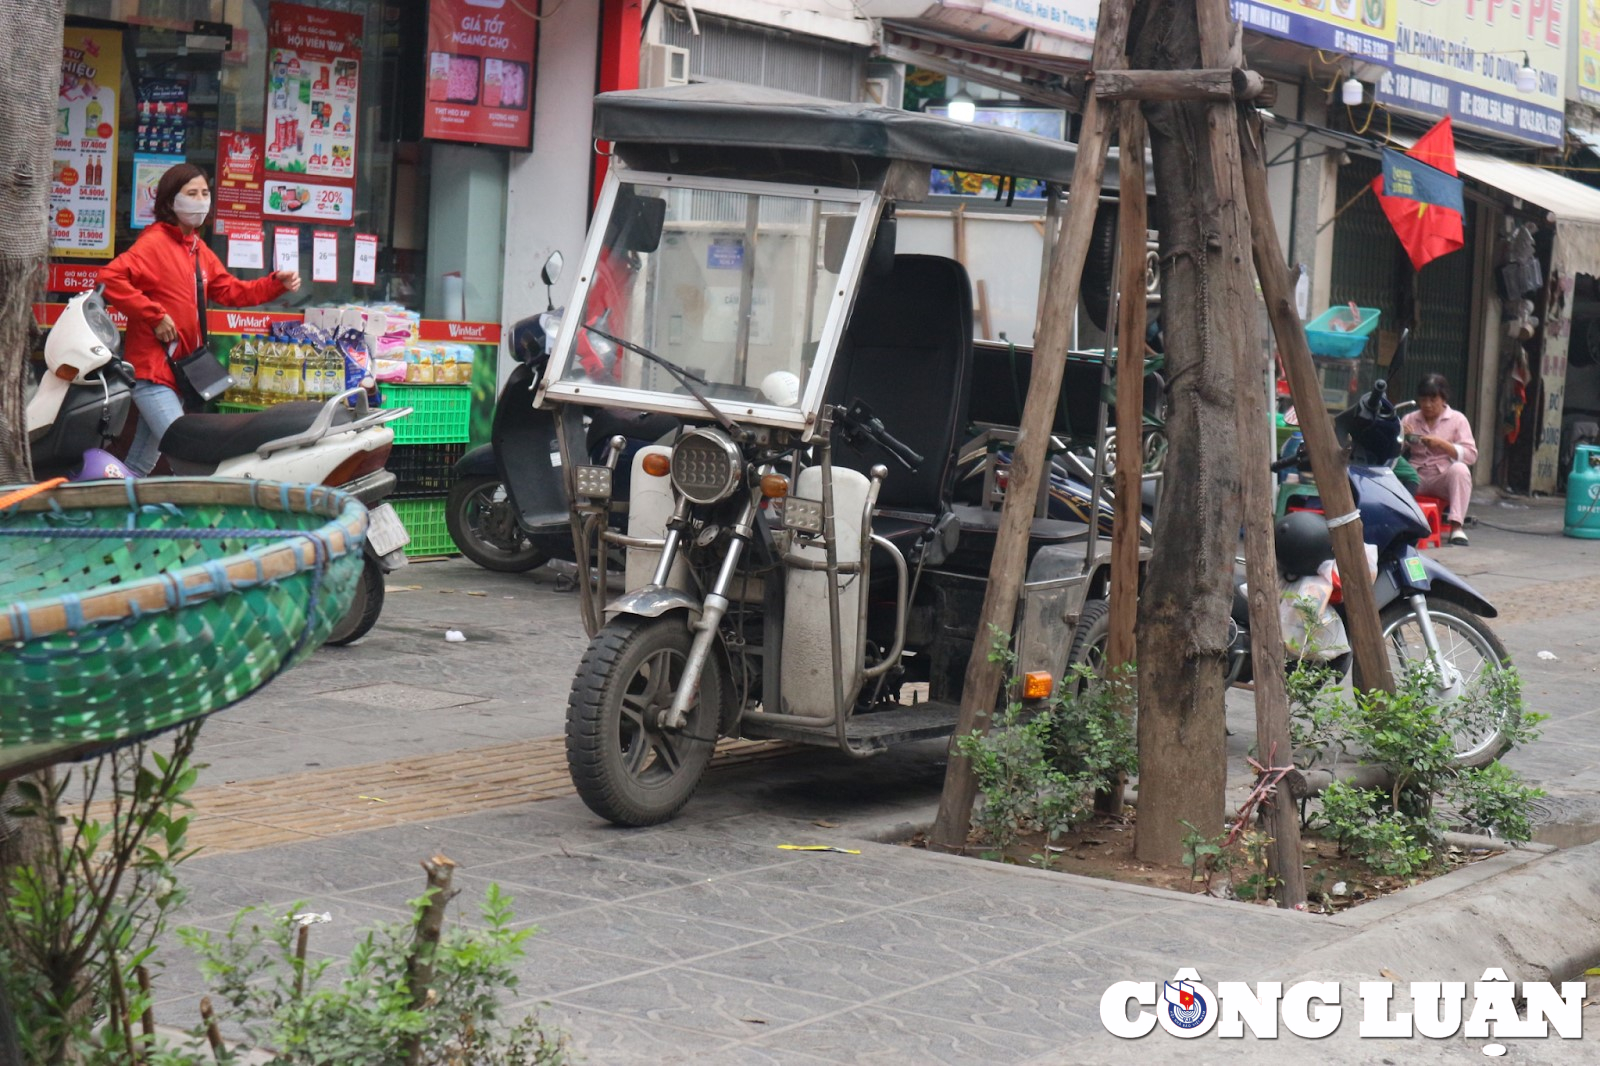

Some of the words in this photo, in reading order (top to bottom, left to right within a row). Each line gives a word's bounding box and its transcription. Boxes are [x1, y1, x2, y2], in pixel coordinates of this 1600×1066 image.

[462, 14, 481, 32] GIÁ
[484, 14, 506, 35] TỐT
[1271, 11, 1290, 34] KHAI
[287, 32, 303, 48] HỘI
[306, 36, 326, 49] VIÊN
[451, 31, 487, 47] NGANG
[488, 37, 510, 52] CHỢ
[1413, 30, 1445, 64] PHÒNG
[1410, 77, 1431, 104] MINH
[1431, 83, 1450, 108] KHAI
[1539, 69, 1559, 97] SINH
[321, 190, 343, 204] 20%
[319, 252, 328, 260] 26
